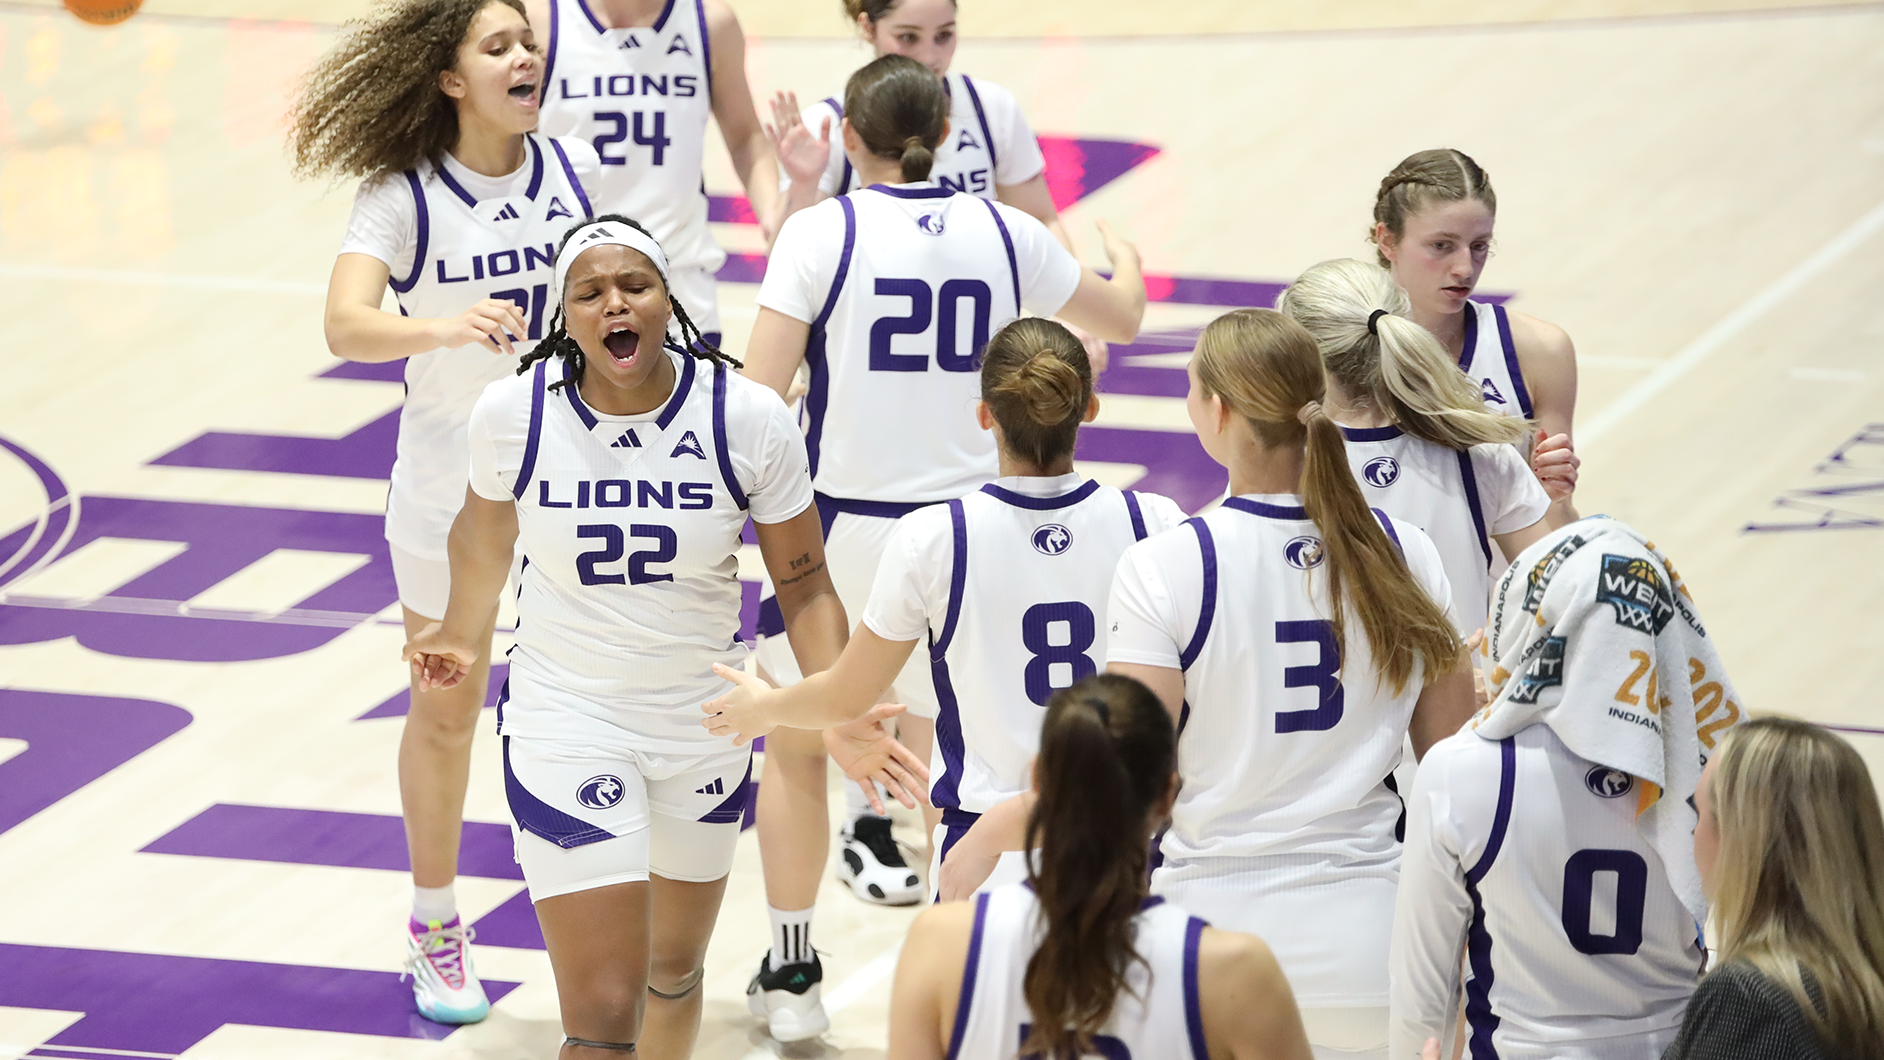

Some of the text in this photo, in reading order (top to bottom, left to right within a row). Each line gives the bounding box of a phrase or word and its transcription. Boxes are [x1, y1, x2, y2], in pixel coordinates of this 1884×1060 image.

[560, 75, 697, 99] LIONS
[592, 111, 671, 166] 24
[436, 242, 556, 284] LION
[868, 277, 992, 373] 20
[538, 479, 714, 510] LIONS
[575, 523, 678, 586] 22
[1492, 560, 1521, 662] INDIANAPOLIS
[1604, 572, 1673, 619] WBIT
[1021, 600, 1098, 708] 8
[1274, 618, 1345, 734] 3
[1608, 706, 1662, 735] INDIAN
[1561, 848, 1648, 956] 0
